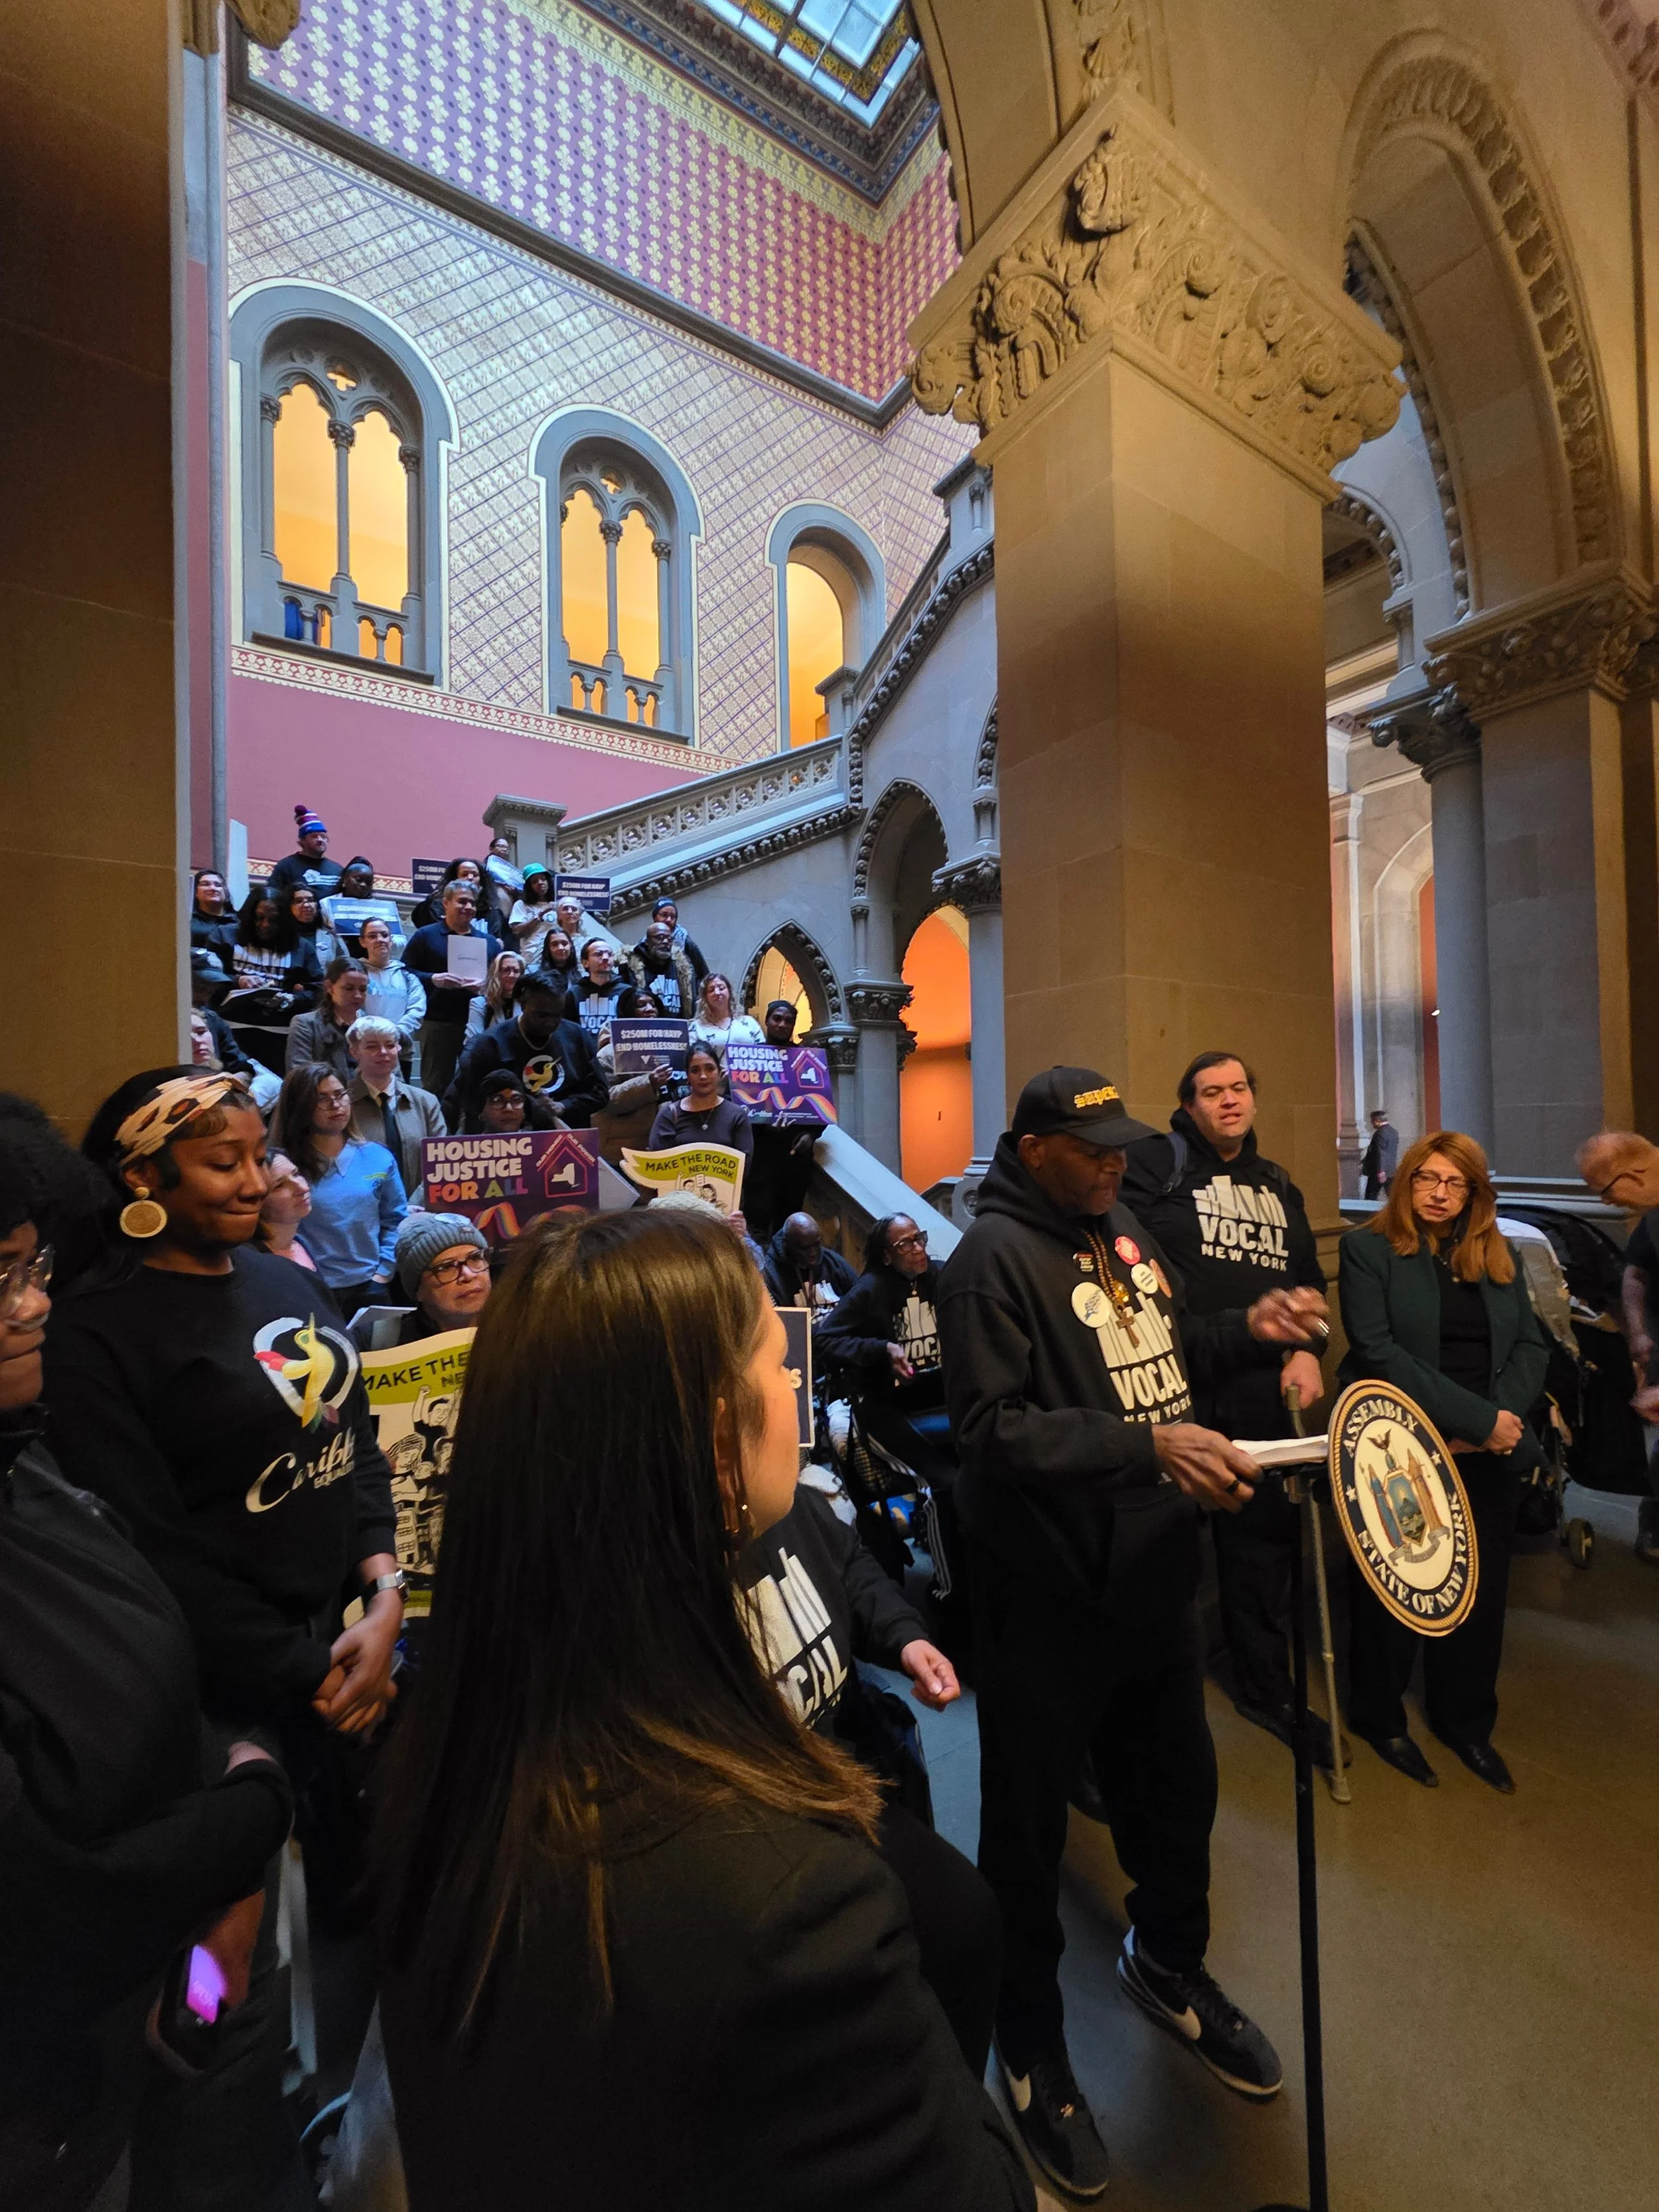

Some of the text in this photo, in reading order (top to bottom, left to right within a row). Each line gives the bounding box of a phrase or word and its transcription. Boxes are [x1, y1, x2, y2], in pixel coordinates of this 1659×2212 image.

[650, 1029, 664, 1038] FOR
[616, 1041, 687, 1051] END HOMELESSNESS
[727, 1047, 788, 1061] HOUSING
[730, 1059, 784, 1072] JUSTICE
[731, 1070, 789, 1084] FOR ALL
[427, 1137, 532, 1161] HOUSING
[427, 1157, 522, 1183] JUSTICE
[645, 1153, 736, 1171] MAKE THE ROAD
[689, 1165, 736, 1179] NEW YORK
[429, 1177, 528, 1203] FOR ALL
[1198, 1215, 1289, 1258] VOCAL
[1201, 1243, 1287, 1272] NEW YORK
[425, 1351, 470, 1375] THE
[441, 1371, 465, 1388] NE
[1110, 1354, 1187, 1410] VOCAL
[1163, 1394, 1192, 1418] YORK
[1343, 1399, 1417, 1459] ASSEMBLY
[1448, 1491, 1468, 1566] YORK
[1358, 1529, 1410, 1605] STATE
[1435, 1565, 1467, 1613] NEW
[1412, 1591, 1435, 1615] OF
